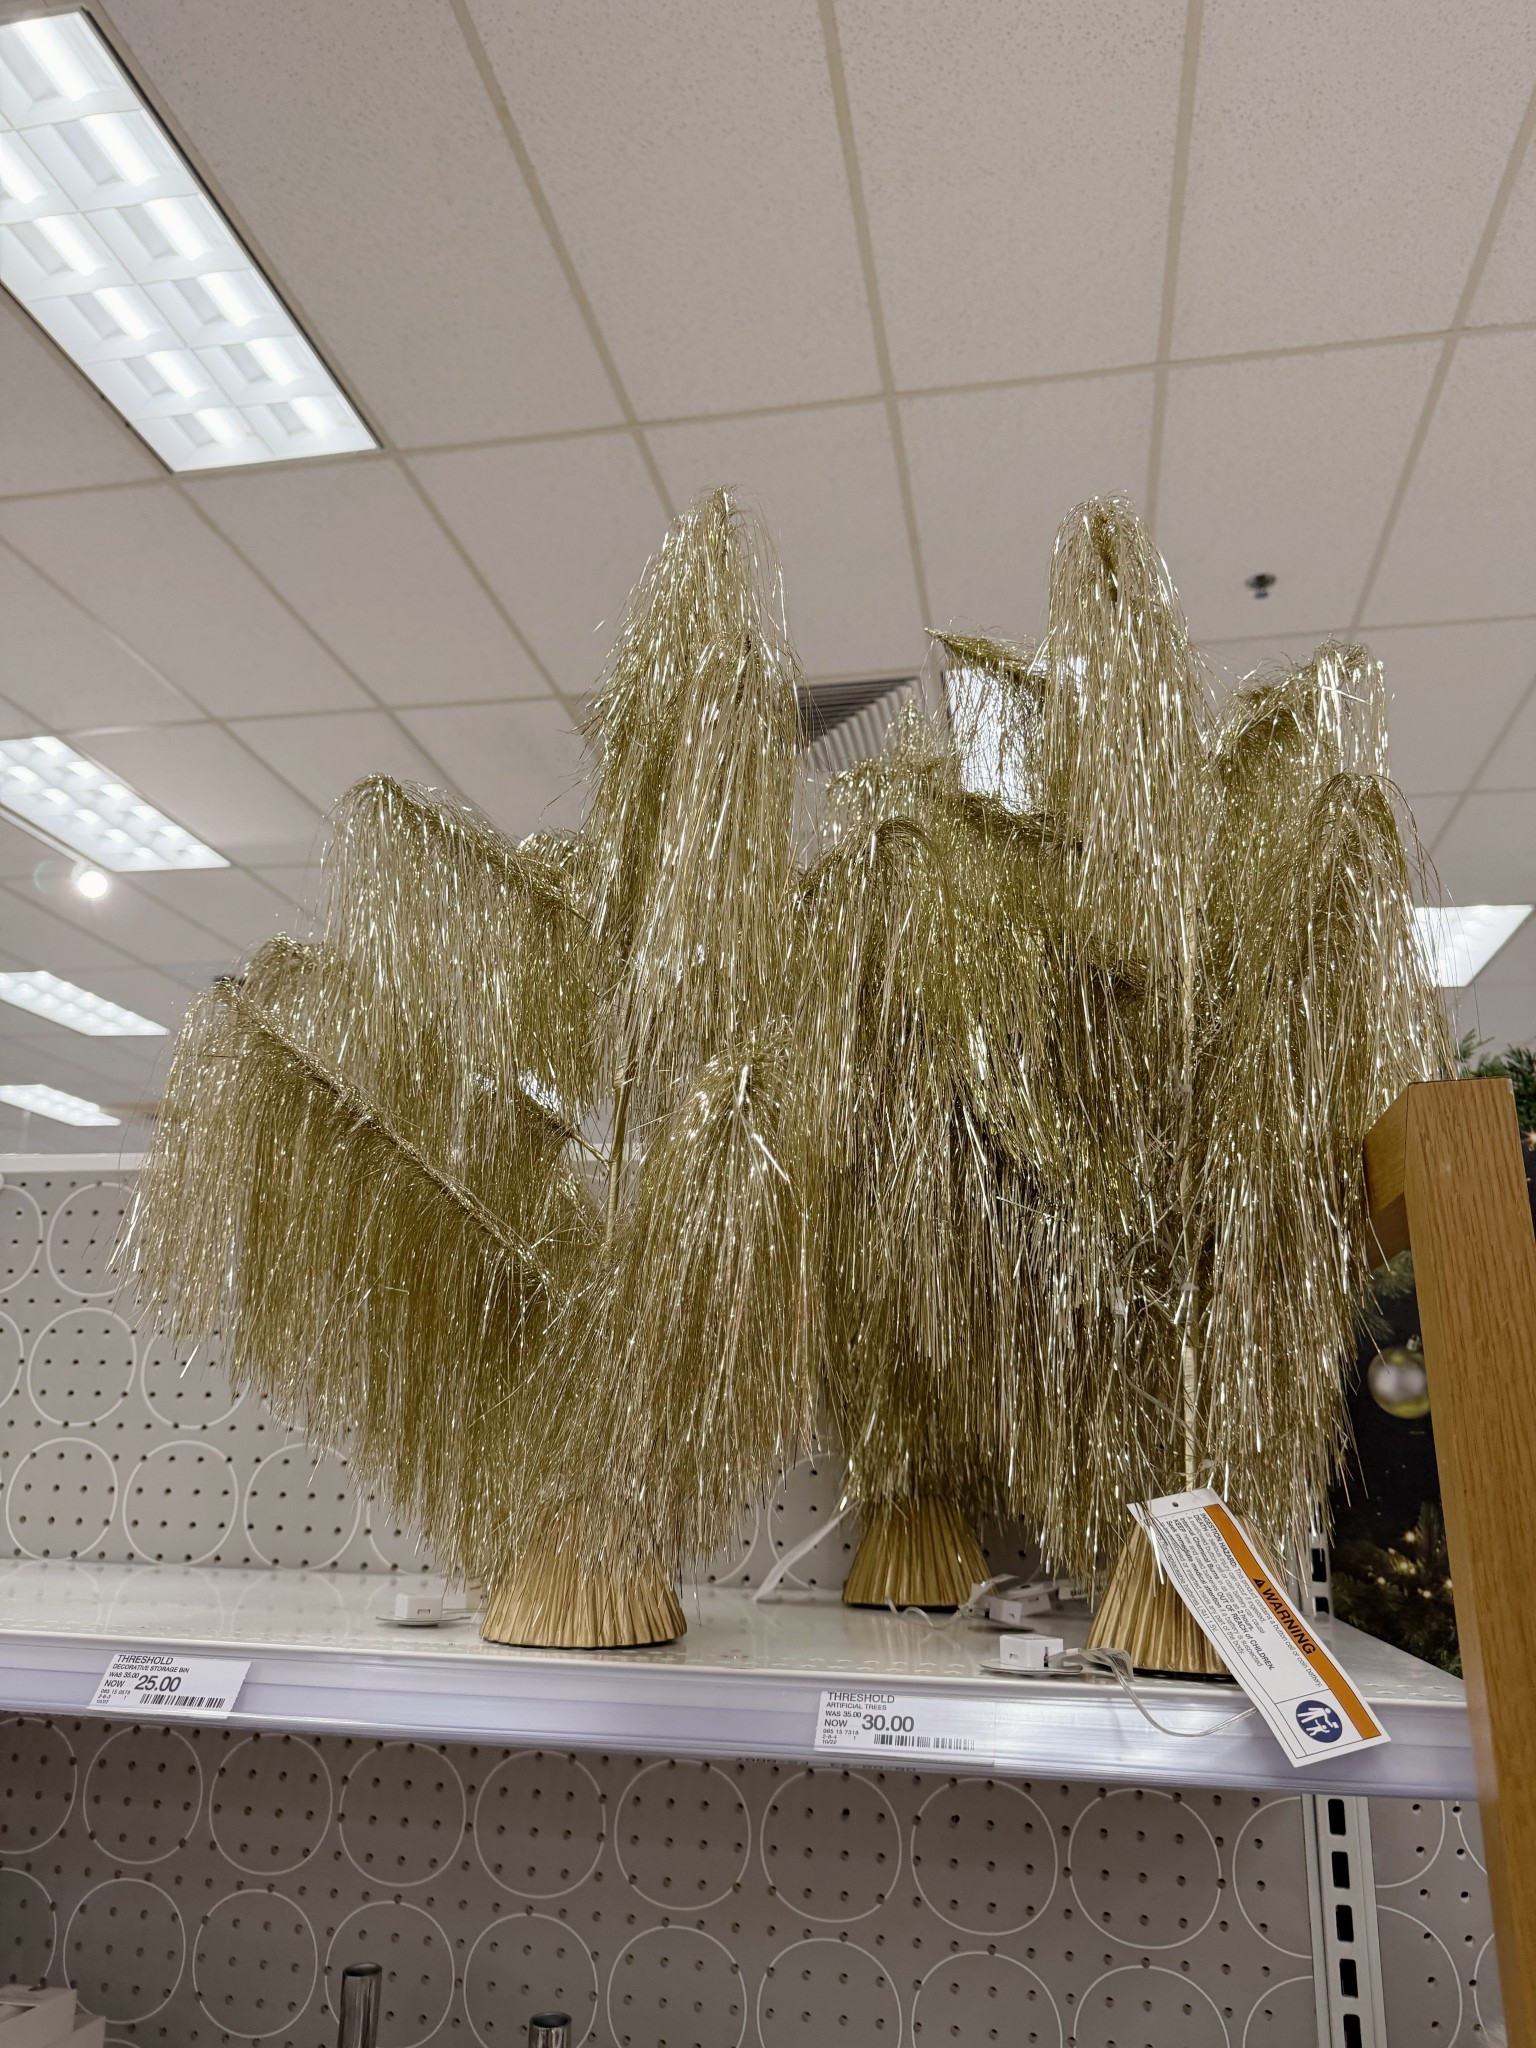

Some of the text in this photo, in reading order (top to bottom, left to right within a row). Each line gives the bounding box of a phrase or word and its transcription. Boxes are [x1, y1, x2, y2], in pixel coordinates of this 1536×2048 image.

[1179, 1517, 1195, 1535] Internal
[1191, 1536, 1211, 1562] Chemical
[1206, 1563, 1221, 1579] Burns
[1189, 1520, 1208, 1545] swallowed
[1204, 1546, 1218, 1563] button
[1214, 1563, 1225, 1572] cell
[1224, 1579, 1236, 1590] coin
[1231, 1590, 1248, 1608] battery
[1243, 1608, 1254, 1618] can
[1251, 1618, 1266, 1633] cause
[1193, 1514, 1208, 1531] DEATH
[1208, 1538, 1223, 1557] serious
[1218, 1557, 1232, 1571] injury
[1227, 1571, 1237, 1581] can
[1234, 1581, 1247, 1596] occur
[1166, 1520, 1178, 1532] Seek
[1174, 1532, 1194, 1562] immediate
[1190, 1562, 1207, 1584] medical
[1203, 1584, 1223, 1608] attention
[1224, 1616, 1240, 1635] battery
[1240, 1639, 1264, 1666] suspected
[1172, 1518, 1186, 1532] KEEP
[1182, 1533, 1192, 1544] new
[1188, 1544, 1199, 1555] and
[1194, 1556, 1206, 1569] used
[1201, 1569, 1220, 1591] batteries
[1215, 1591, 1229, 1604] OUT
[1224, 1604, 1235, 1612] OF
[1230, 1612, 1249, 1632] REACH
[1249, 1639, 1277, 1671] CHILDREN.
[1185, 1568, 1202, 1589] inserted
[1198, 1589, 1212, 1604] inside
[1207, 1604, 1218, 1614] any
[1213, 1614, 1225, 1625] part
[1225, 1631, 1236, 1640] the
[1199, 1512, 1223, 1541] INGESTION
[1217, 1541, 1238, 1568] HAZARD:
[1234, 1568, 1244, 1579] This
[1239, 1579, 1258, 1598] product
[1254, 1599, 1274, 1620] contains
[1272, 1623, 1289, 1641] button
[1284, 1641, 1296, 1650] cell
[1296, 1657, 1309, 1668] coin
[1260, 1589, 1317, 1654] WARNING
[104, 1674, 182, 1692] NOW 25.00
[118, 1655, 173, 1665] THRESHOLD
[824, 1714, 915, 1732] NOW 30.00
[826, 1702, 863, 1710] ARTIFICIAL
[828, 1692, 894, 1703] THRESHOLD
